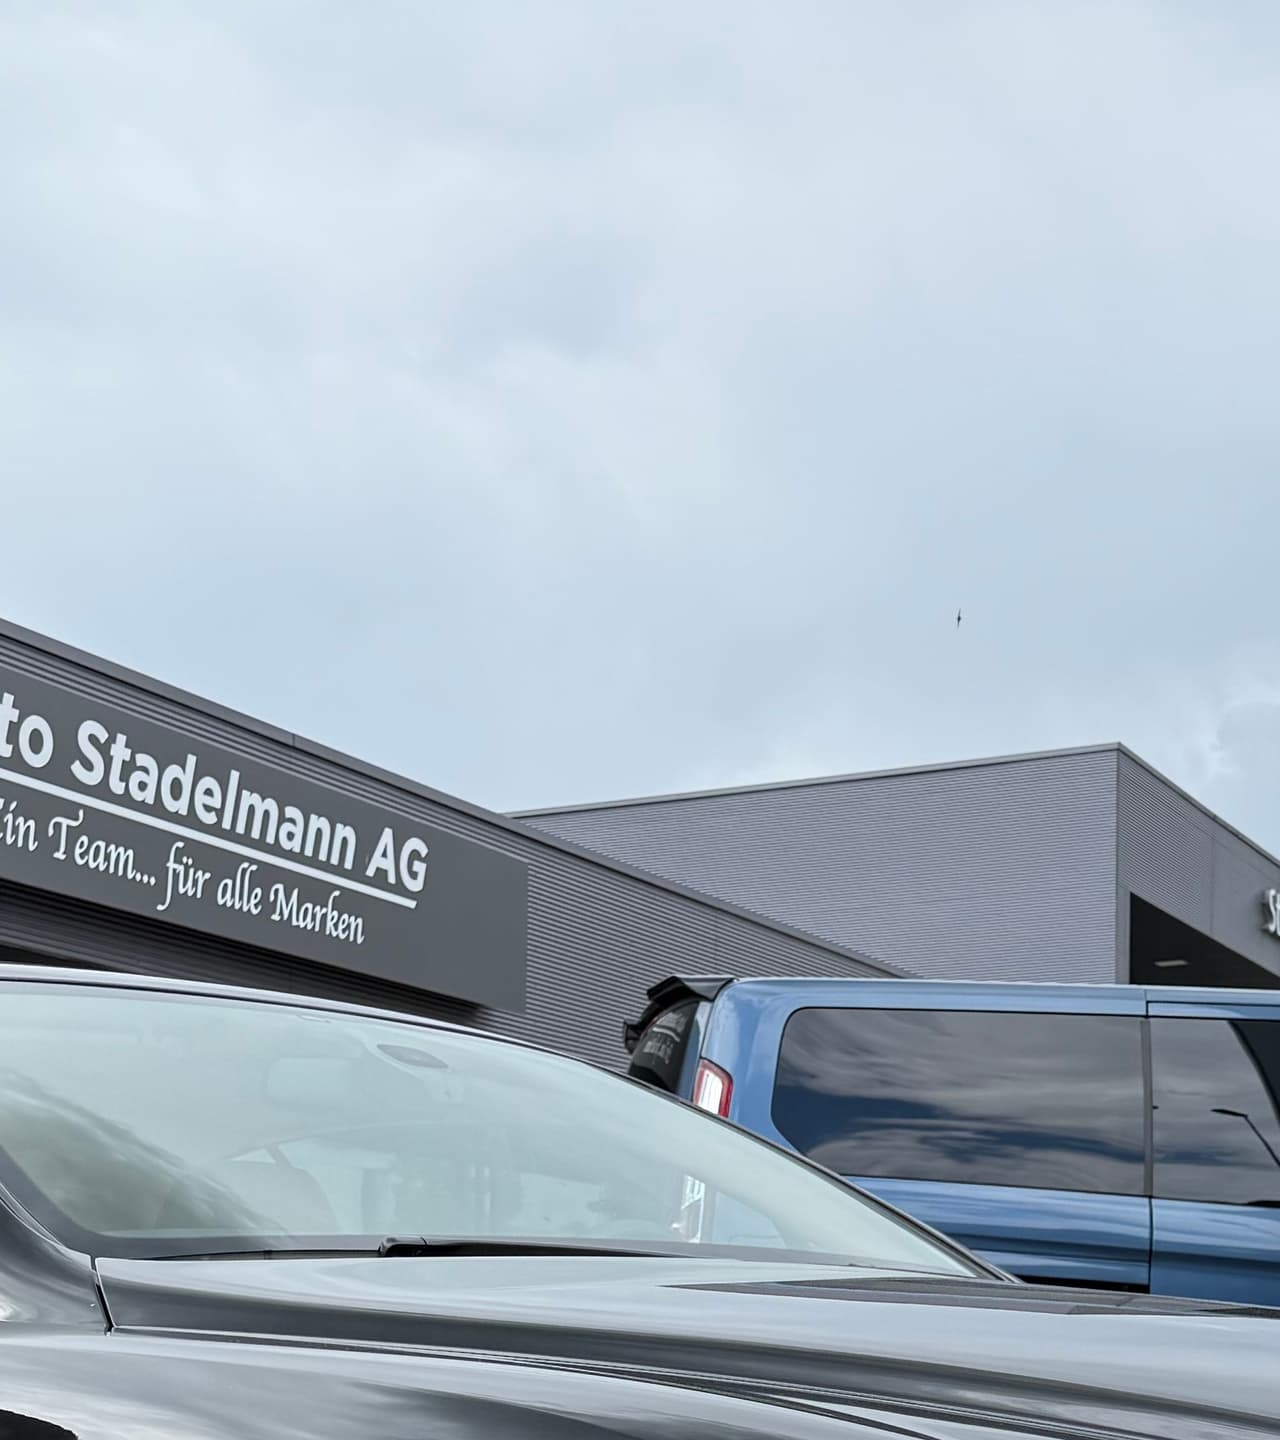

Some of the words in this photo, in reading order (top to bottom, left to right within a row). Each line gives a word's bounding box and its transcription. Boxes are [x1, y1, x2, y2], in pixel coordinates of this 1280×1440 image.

[48, 809, 157, 886] Team...
[157, 842, 211, 911] für
[216, 862, 262, 914] alle
[269, 881, 365, 945] Marken
[70, 719, 356, 869] Stadelmann
[366, 825, 429, 893] AG
